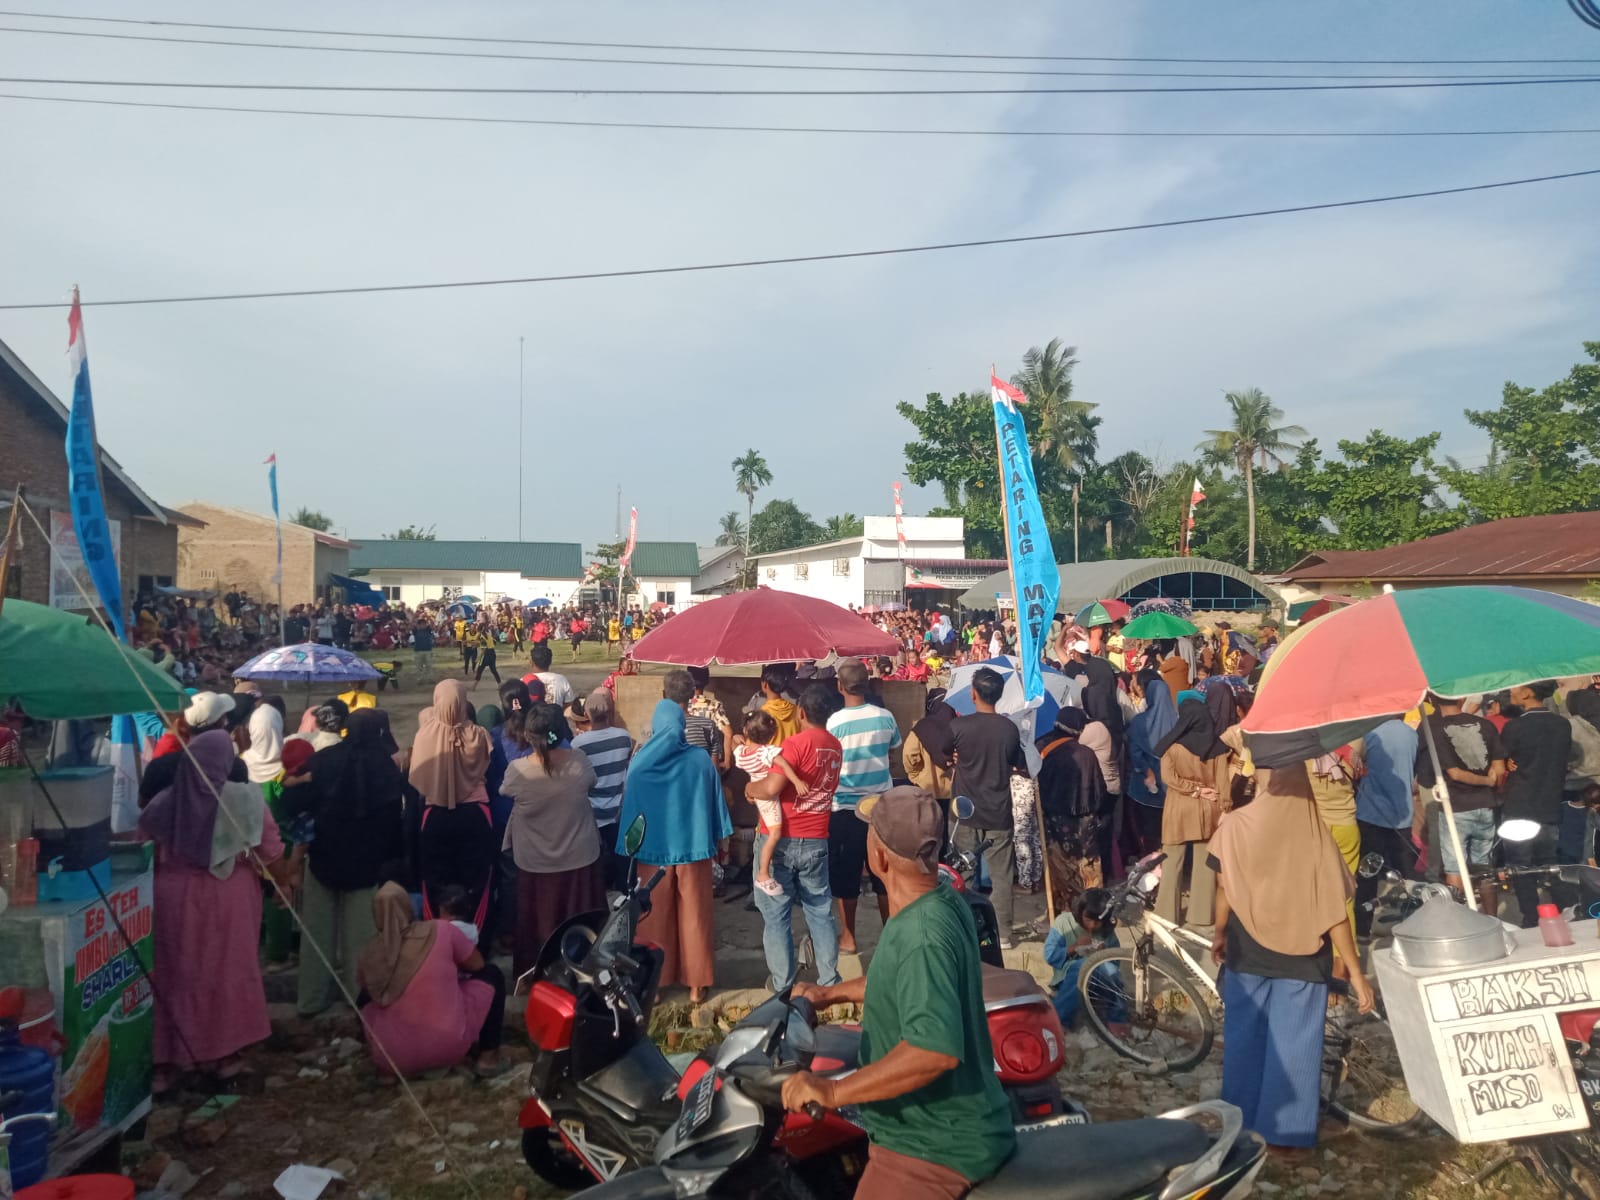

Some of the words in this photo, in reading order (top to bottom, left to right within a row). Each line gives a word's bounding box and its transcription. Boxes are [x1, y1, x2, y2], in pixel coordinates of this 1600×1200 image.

[1001, 423, 1034, 556] PETARING
[110, 886, 138, 914] TEH
[1453, 1024, 1544, 1076] KUAH
[1469, 1073, 1543, 1115] MISO
